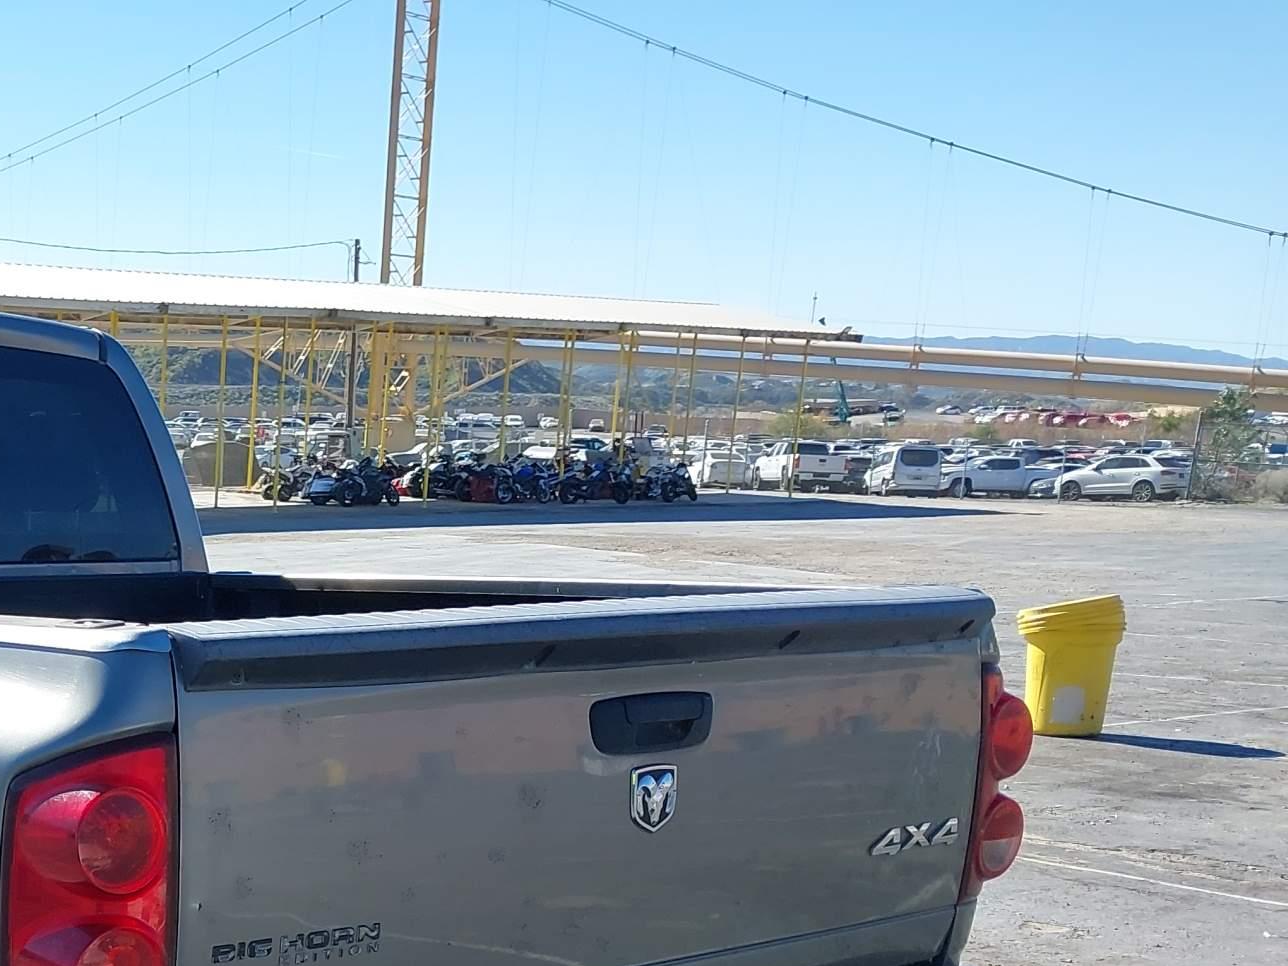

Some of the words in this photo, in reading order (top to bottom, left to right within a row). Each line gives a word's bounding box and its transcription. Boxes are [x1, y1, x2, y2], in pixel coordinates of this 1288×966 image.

[869, 817, 960, 857] 4X4
[211, 938, 274, 964] BIG
[279, 922, 382, 954] HORN
